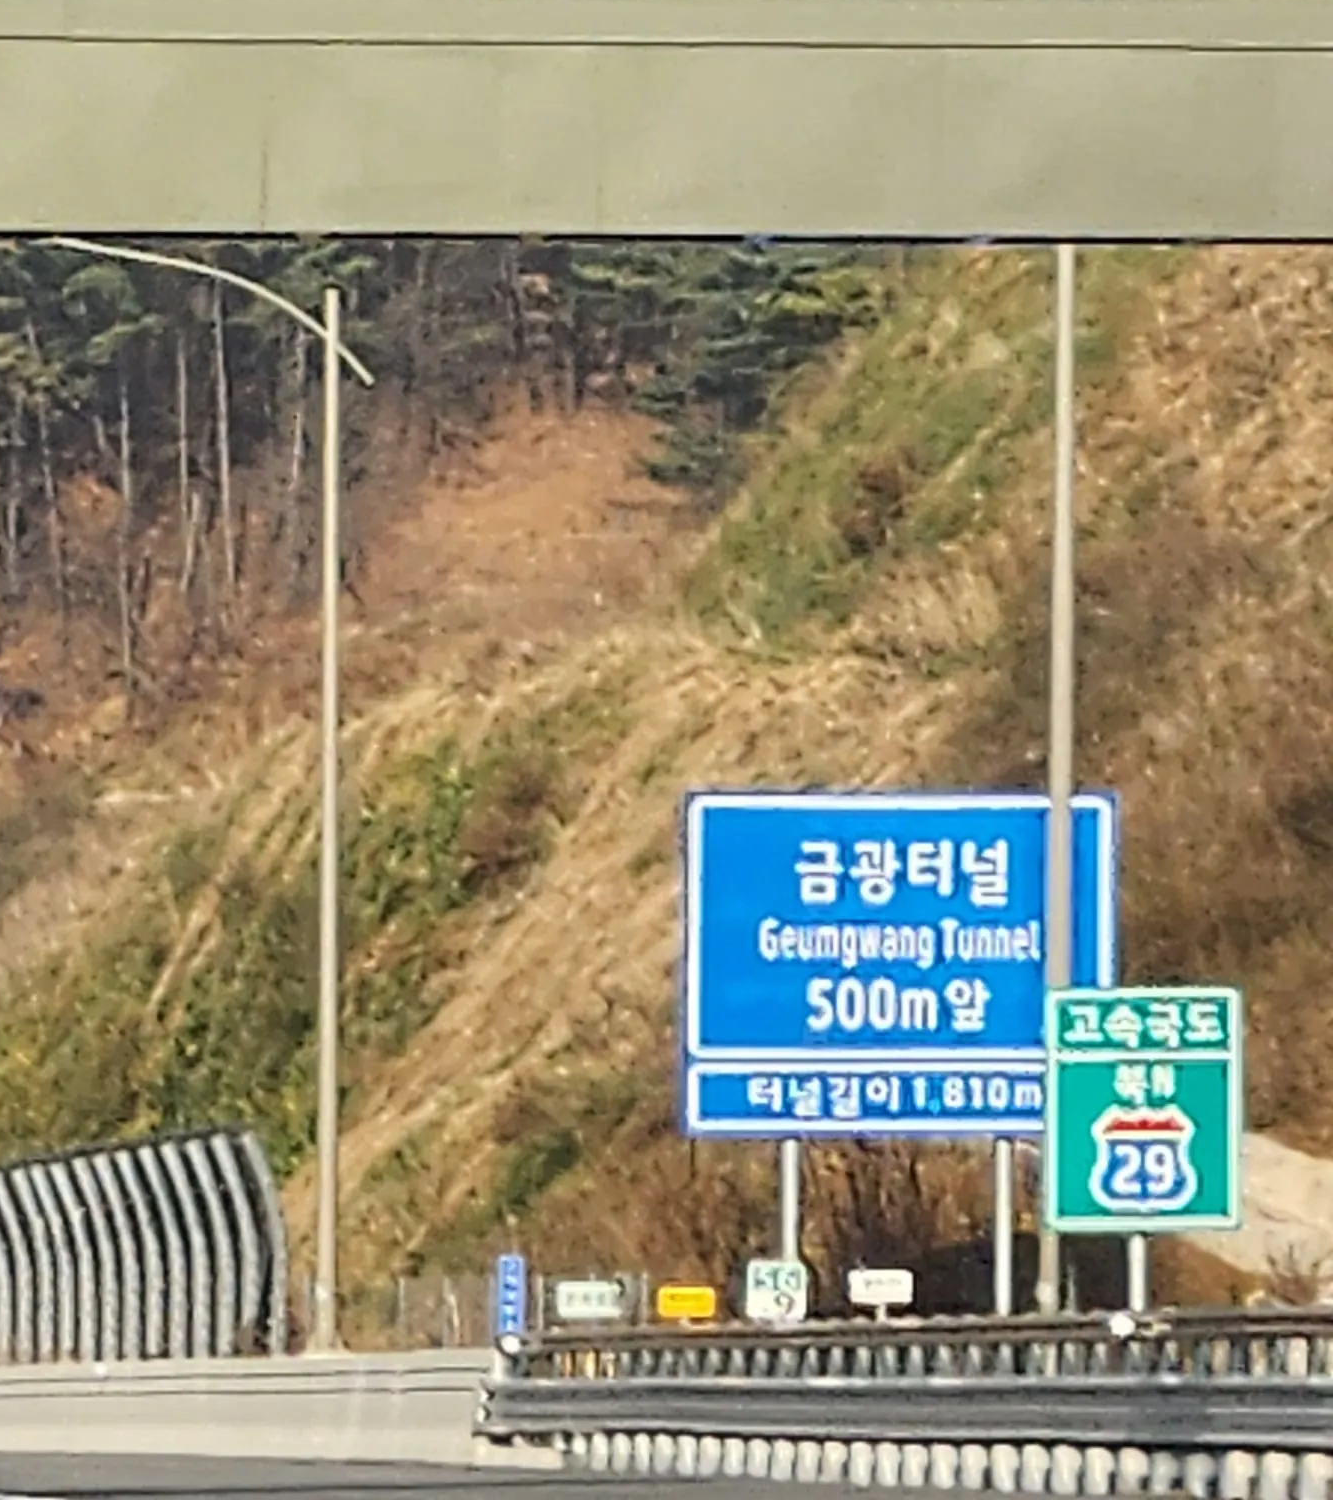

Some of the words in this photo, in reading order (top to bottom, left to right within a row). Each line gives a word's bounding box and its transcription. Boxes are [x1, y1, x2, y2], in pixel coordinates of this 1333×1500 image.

[794, 837, 1009, 907] 금광터널
[758, 916, 935, 970] Geumgwang
[937, 917, 1042, 962] Tunnel
[805, 976, 939, 1033] 500m
[942, 977, 993, 1033] 앞
[1062, 1003, 1225, 1049] 고속국도
[746, 1074, 902, 1118] 터널길이
[1109, 1144, 1176, 1195] 29
